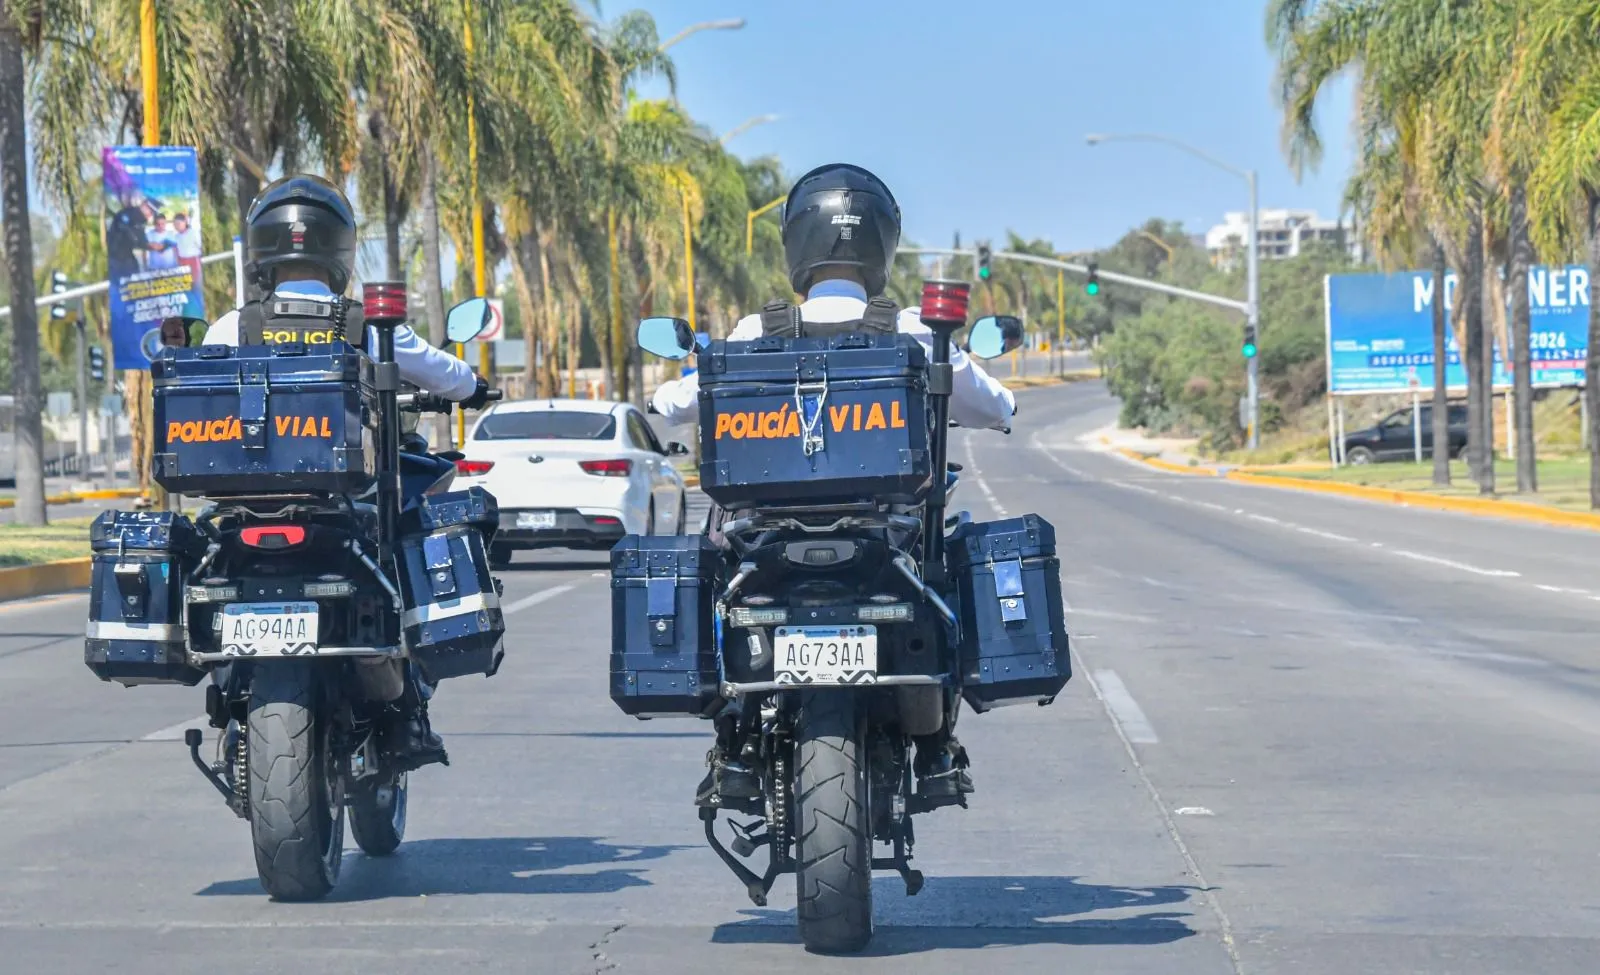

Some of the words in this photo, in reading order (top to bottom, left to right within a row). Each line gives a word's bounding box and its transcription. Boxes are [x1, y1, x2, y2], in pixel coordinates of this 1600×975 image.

[166, 415, 243, 443] POLICÍA
[275, 415, 332, 439] VIAL
[715, 402, 800, 440] POLICÍA
[829, 400, 905, 432] VIAL
[233, 617, 306, 640] AG94AA
[786, 641, 865, 666] AG73AA
